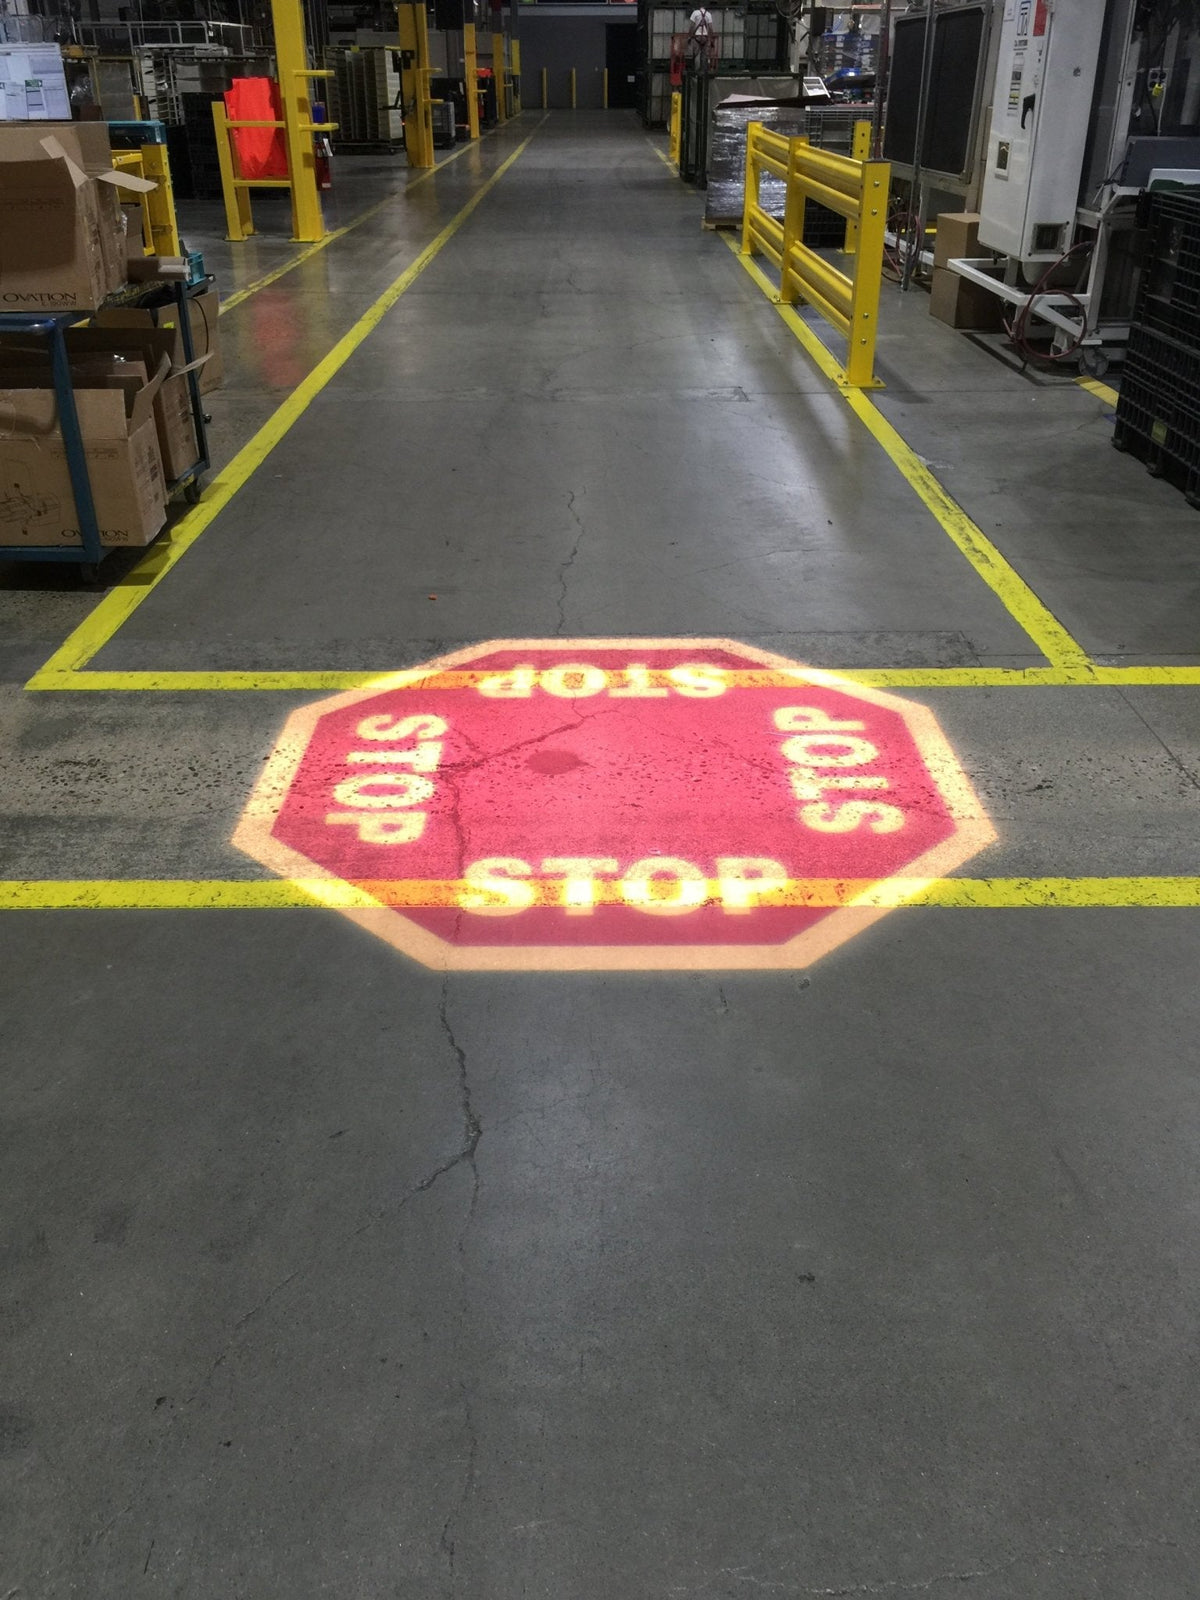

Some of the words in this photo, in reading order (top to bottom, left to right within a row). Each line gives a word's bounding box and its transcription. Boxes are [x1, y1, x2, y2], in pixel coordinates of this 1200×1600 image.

[3, 293, 76, 302] OVATION
[478, 662, 728, 698] STOP
[326, 714, 448, 845] STOP
[774, 706, 905, 833] STOP
[460, 857, 788, 916] STOP
